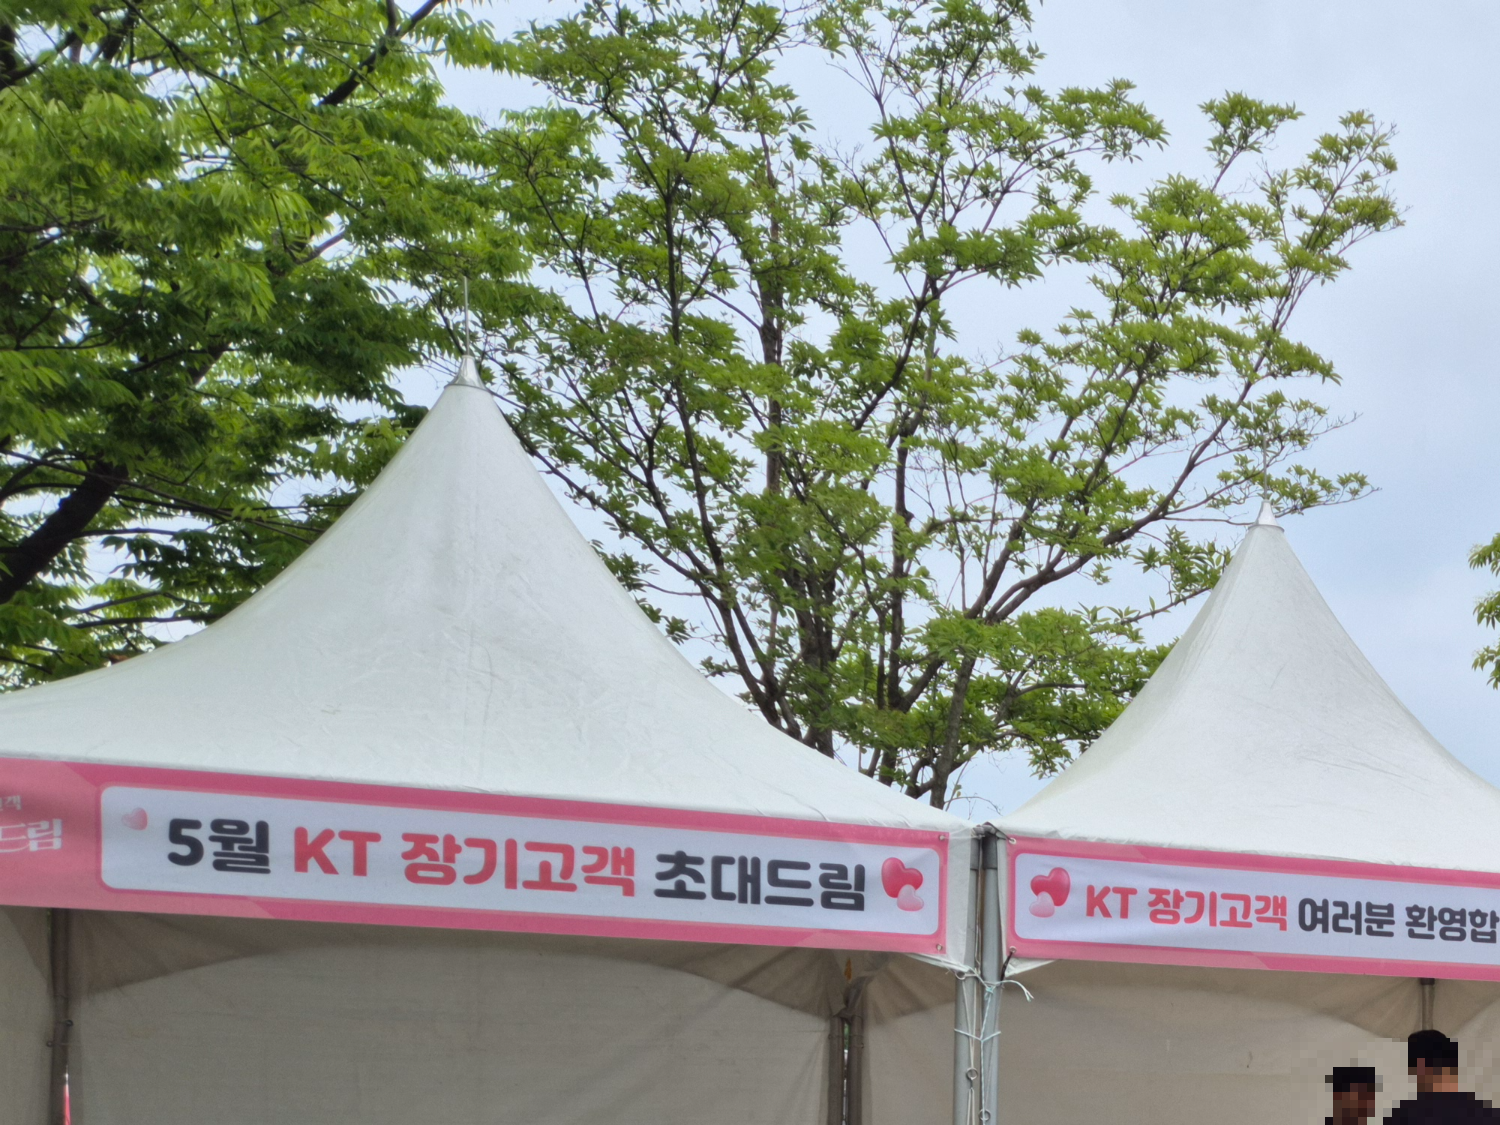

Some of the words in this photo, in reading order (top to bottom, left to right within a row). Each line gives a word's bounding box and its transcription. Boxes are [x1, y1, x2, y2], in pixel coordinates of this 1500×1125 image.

[167, 817, 272, 875] 5월
[293, 826, 382, 878] KT
[400, 832, 636, 898] 장기고객
[654, 849, 868, 912] 초대드림
[1086, 884, 1138, 919] KT
[1147, 887, 1288, 931] 장기고객
[1298, 897, 1396, 938] 여러분
